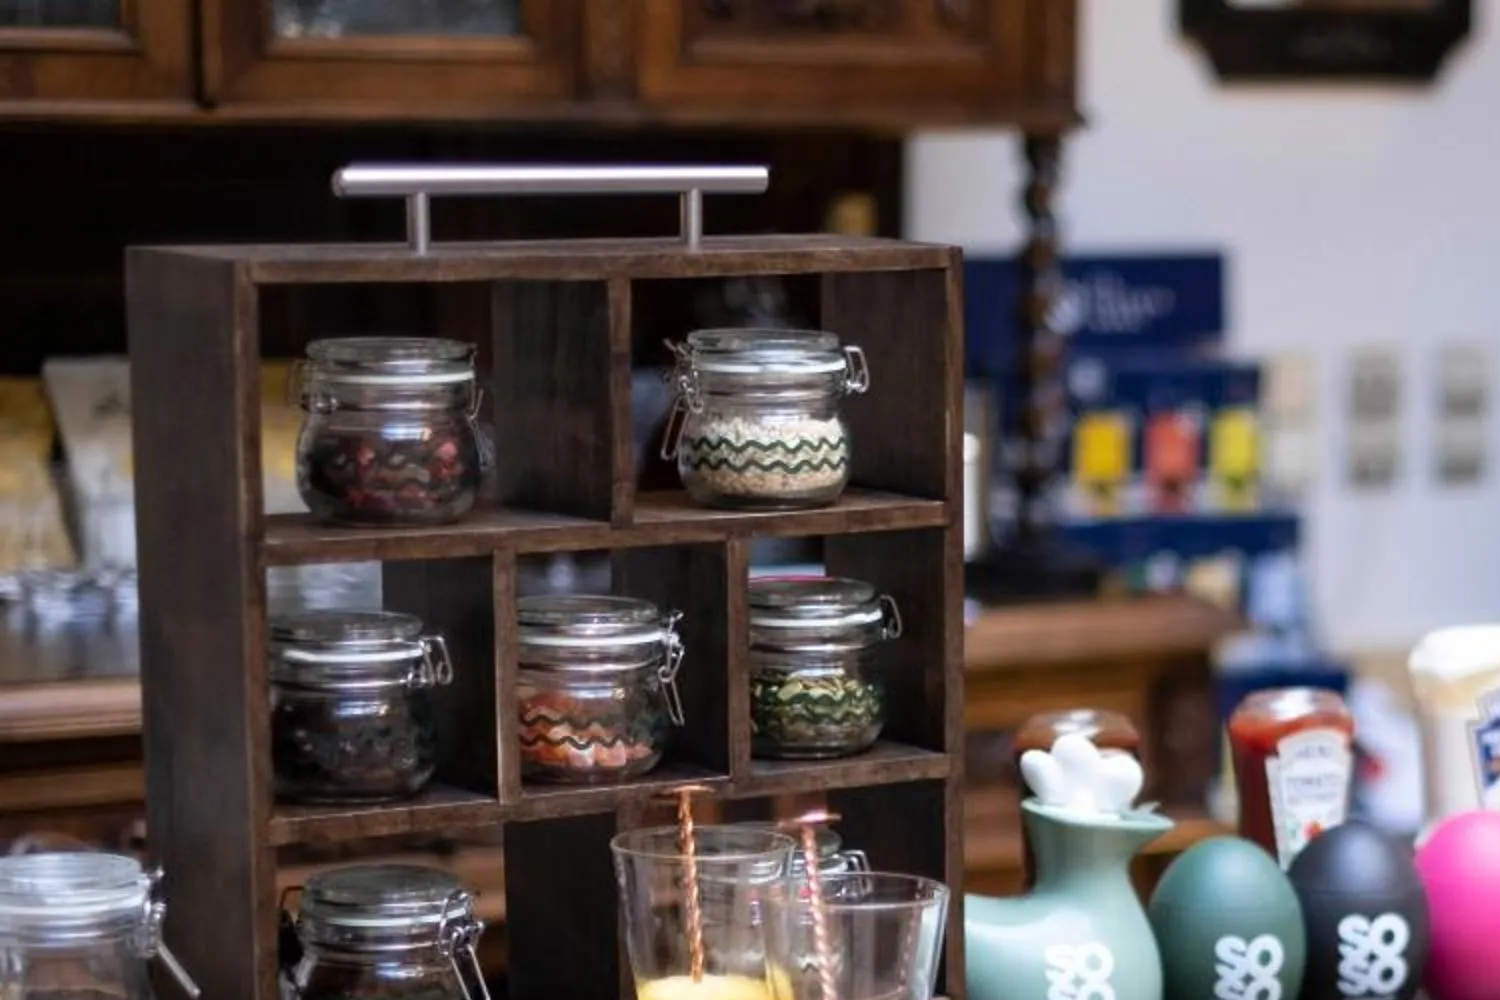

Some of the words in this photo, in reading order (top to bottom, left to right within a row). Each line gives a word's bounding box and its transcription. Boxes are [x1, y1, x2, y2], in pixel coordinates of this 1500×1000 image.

[1213, 934, 1285, 977] SO
[1337, 913, 1410, 957] SO
[1043, 941, 1115, 980] SO
[1337, 953, 1409, 996] SO
